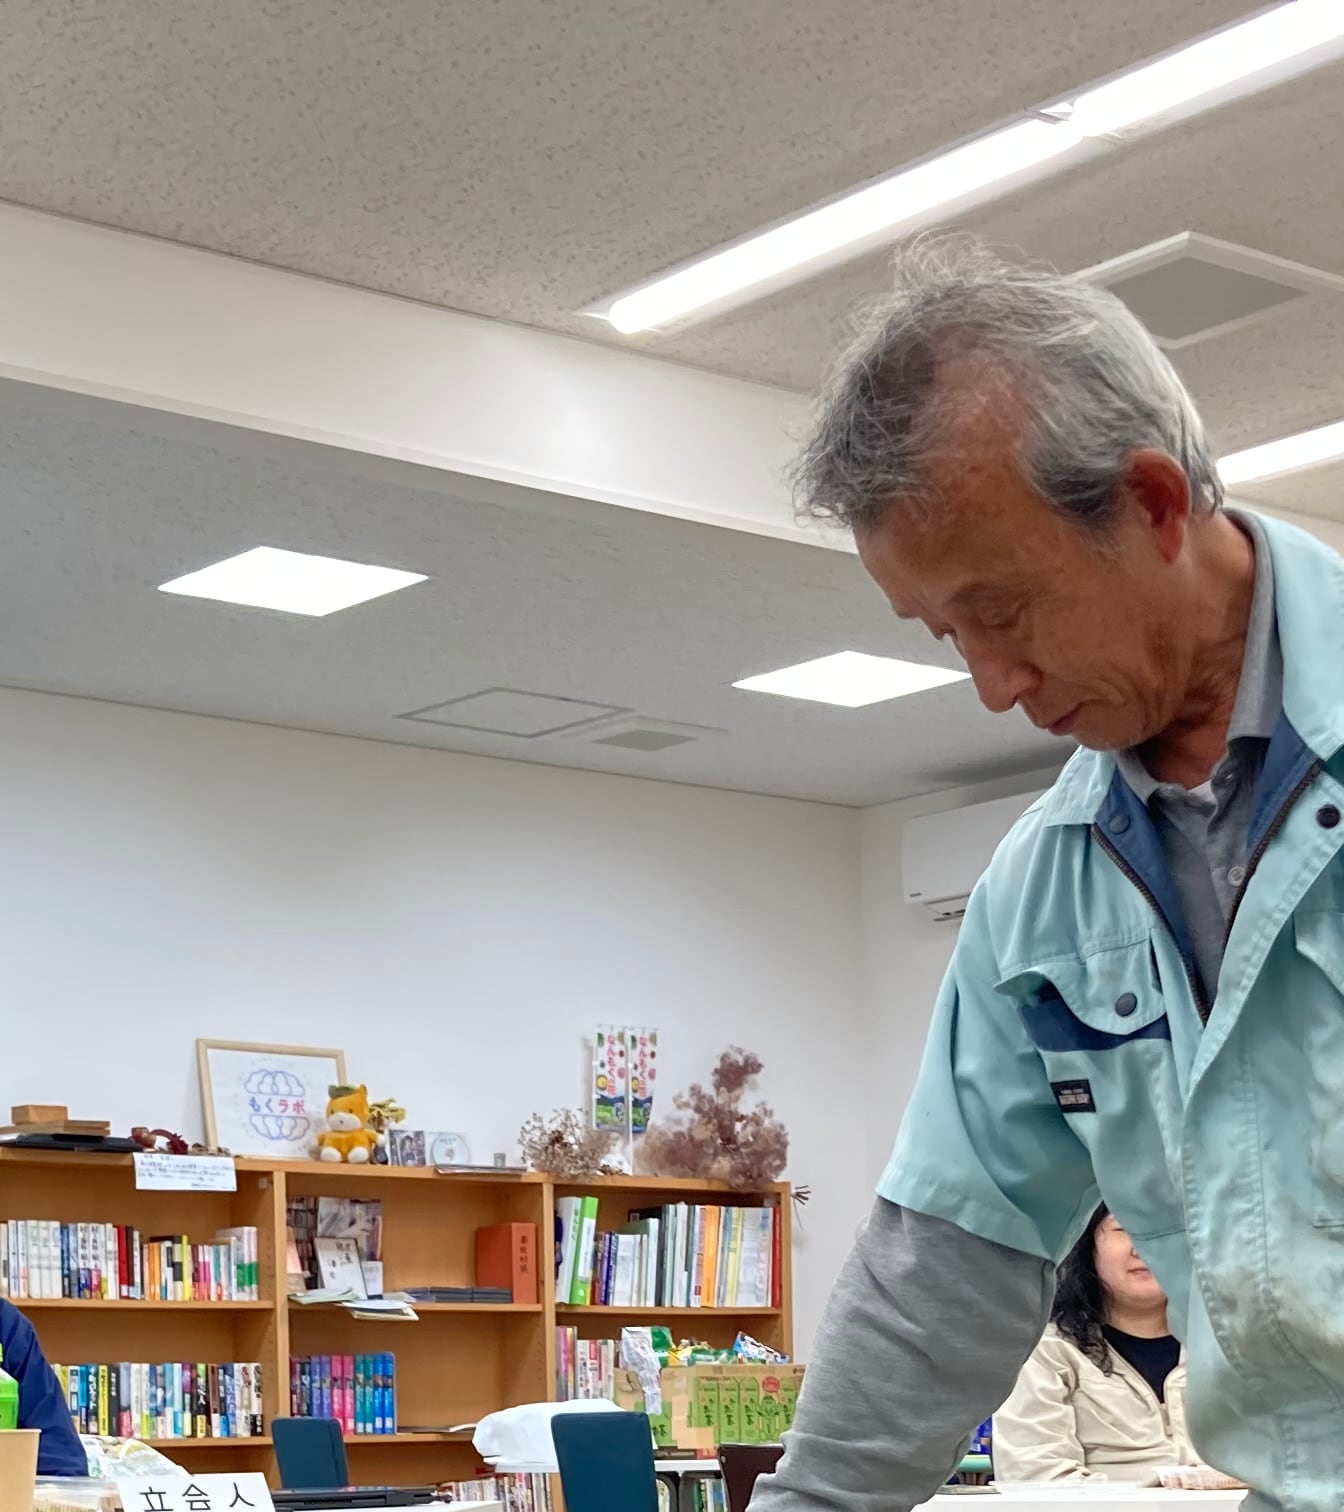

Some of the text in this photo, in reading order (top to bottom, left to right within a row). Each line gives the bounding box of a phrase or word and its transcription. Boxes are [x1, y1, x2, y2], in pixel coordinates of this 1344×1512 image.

[248, 1096, 305, 1114] もくラボ
[139, 1482, 256, 1512] 立会人
